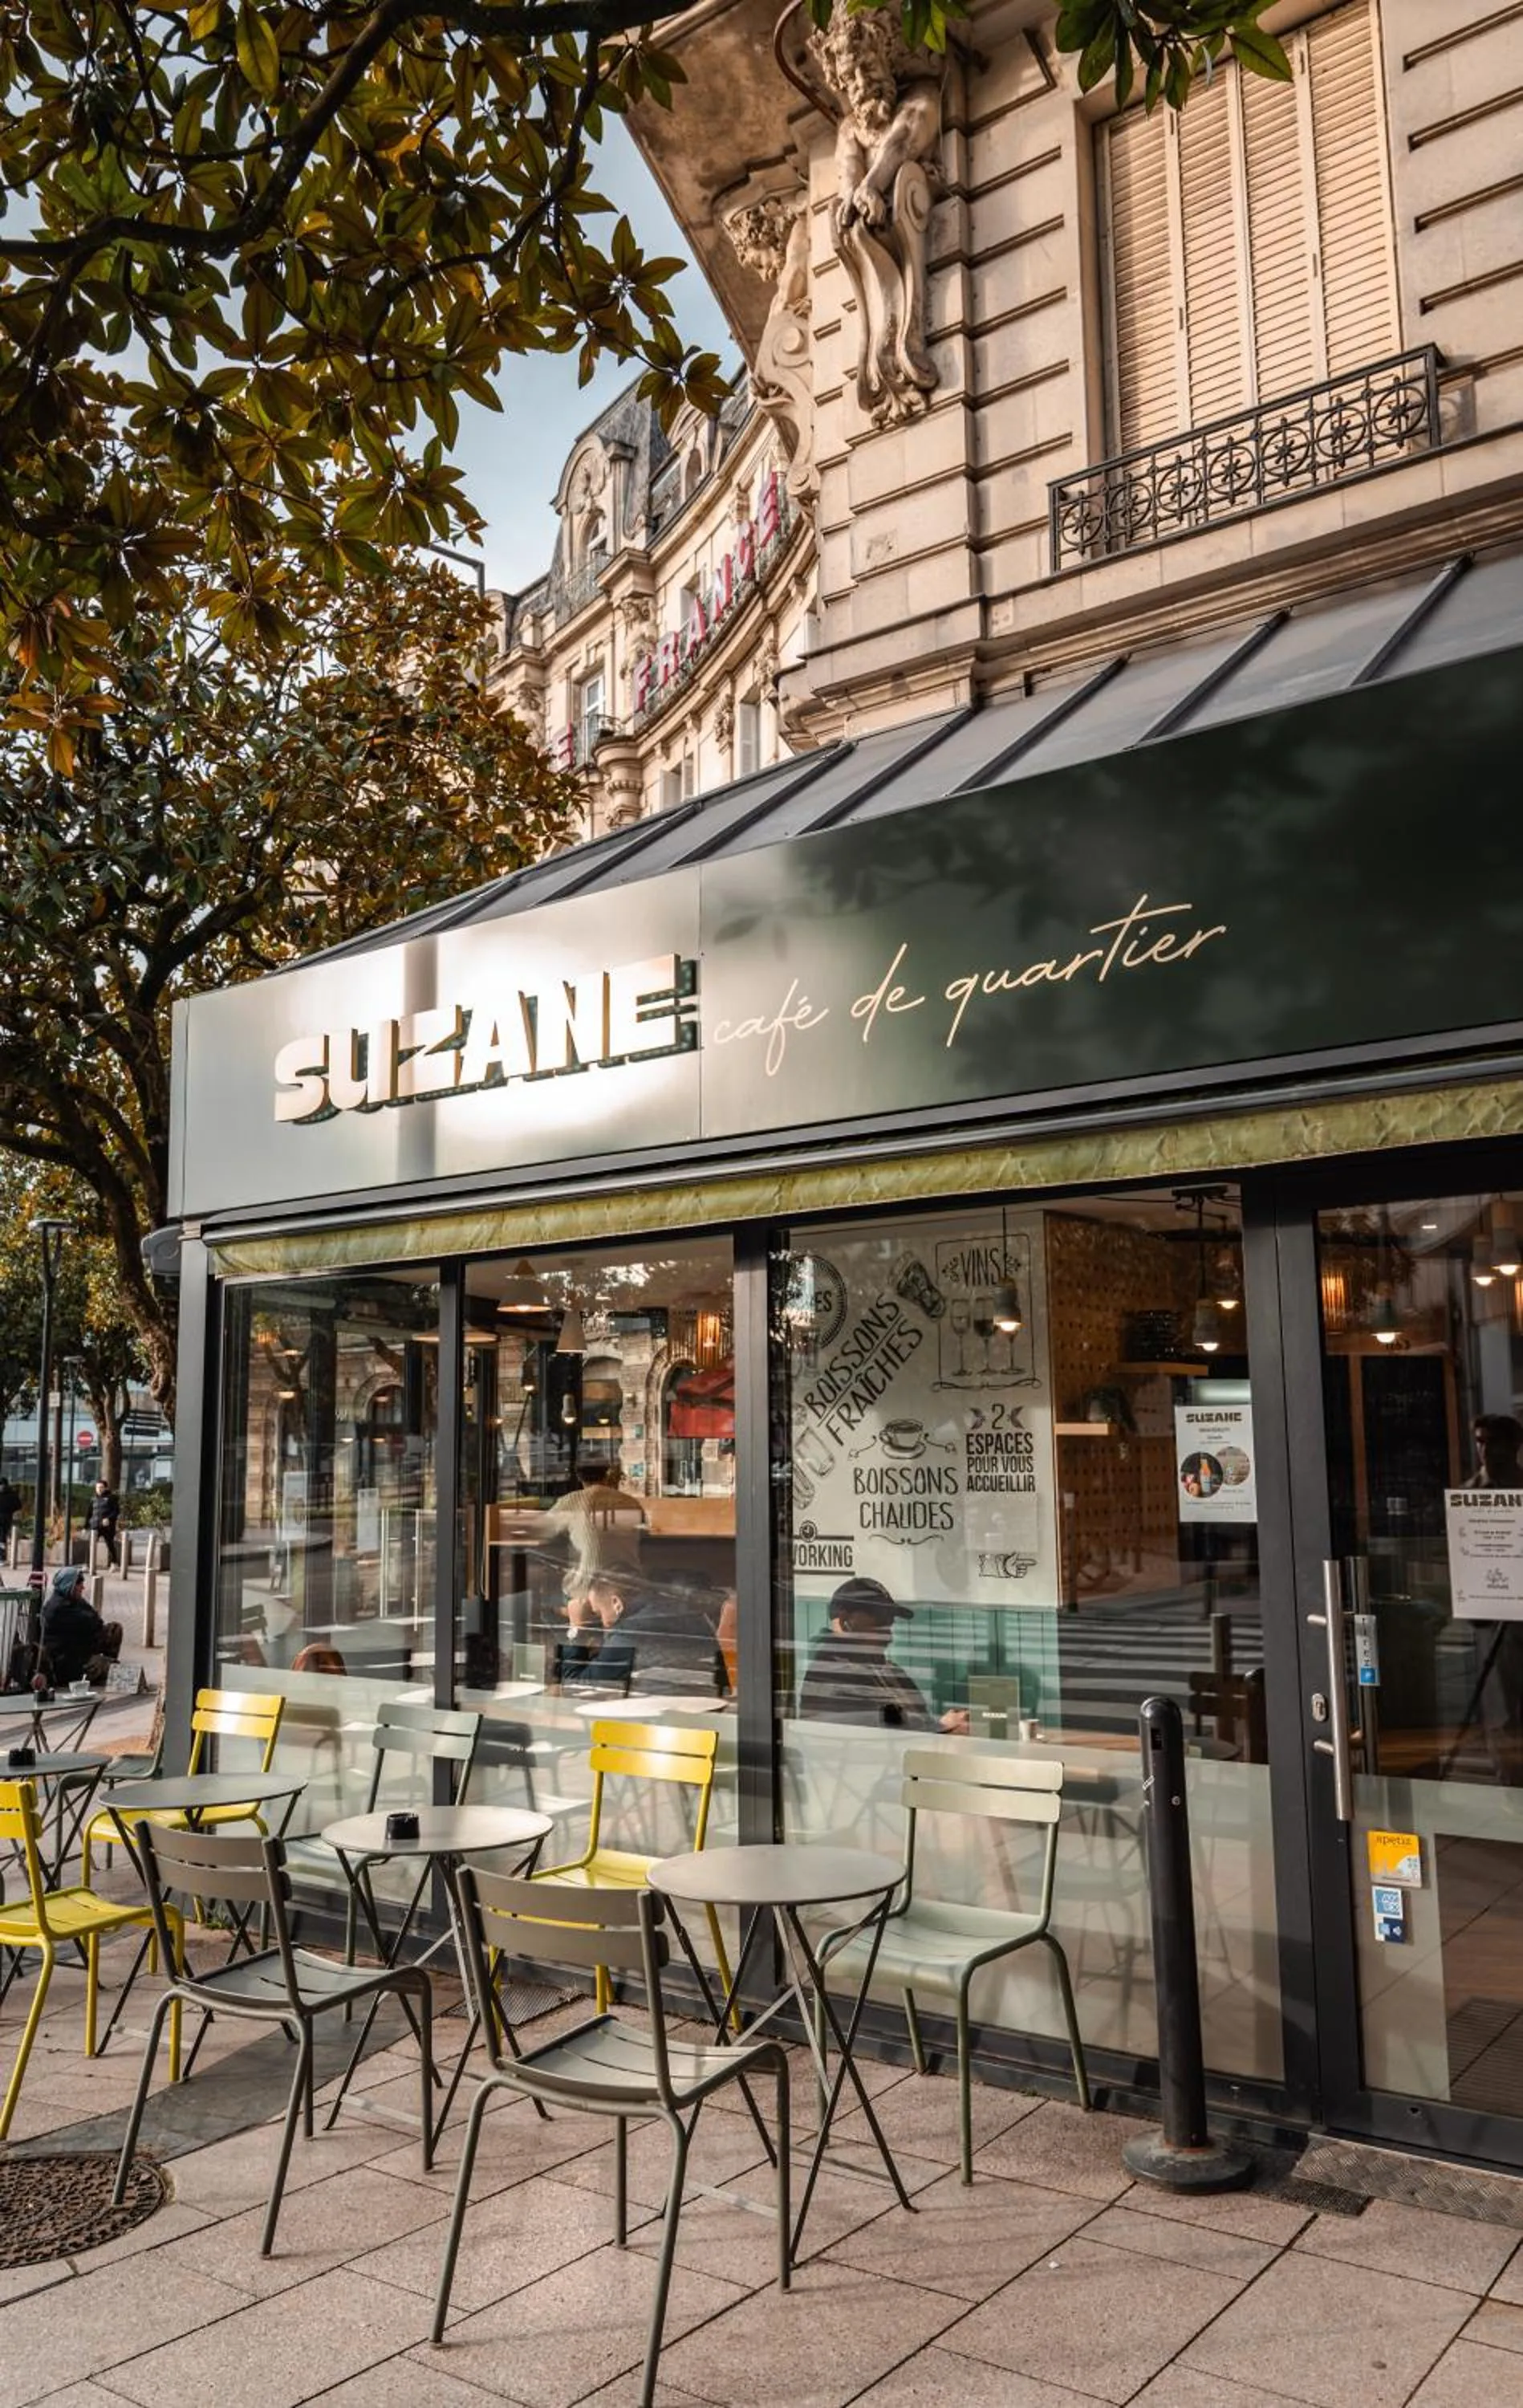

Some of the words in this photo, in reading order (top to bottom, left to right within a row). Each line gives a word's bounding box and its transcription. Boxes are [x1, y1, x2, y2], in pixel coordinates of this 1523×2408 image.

[713, 979, 829, 1076] café
[851, 943, 925, 1043] de
[945, 893, 1226, 1047] quartier
[274, 953, 701, 1125] SUZANE
[961, 1247, 1001, 1287] VINS
[804, 1293, 900, 1419] BOISSONS
[826, 1319, 923, 1446] FRAÎCHES
[992, 1403, 1005, 1430] 2
[1186, 1412, 1242, 1422] SUZANE
[966, 1433, 1034, 1454] ESPACES
[967, 1456, 998, 1473] POUR
[1001, 1455, 1034, 1473] VOUS
[853, 1466, 958, 1495] BOISSONS
[967, 1474, 1035, 1492] ACCUEILLIR
[1450, 1494, 1522, 1507] SUZAN
[860, 1501, 954, 1530] CHAUDES
